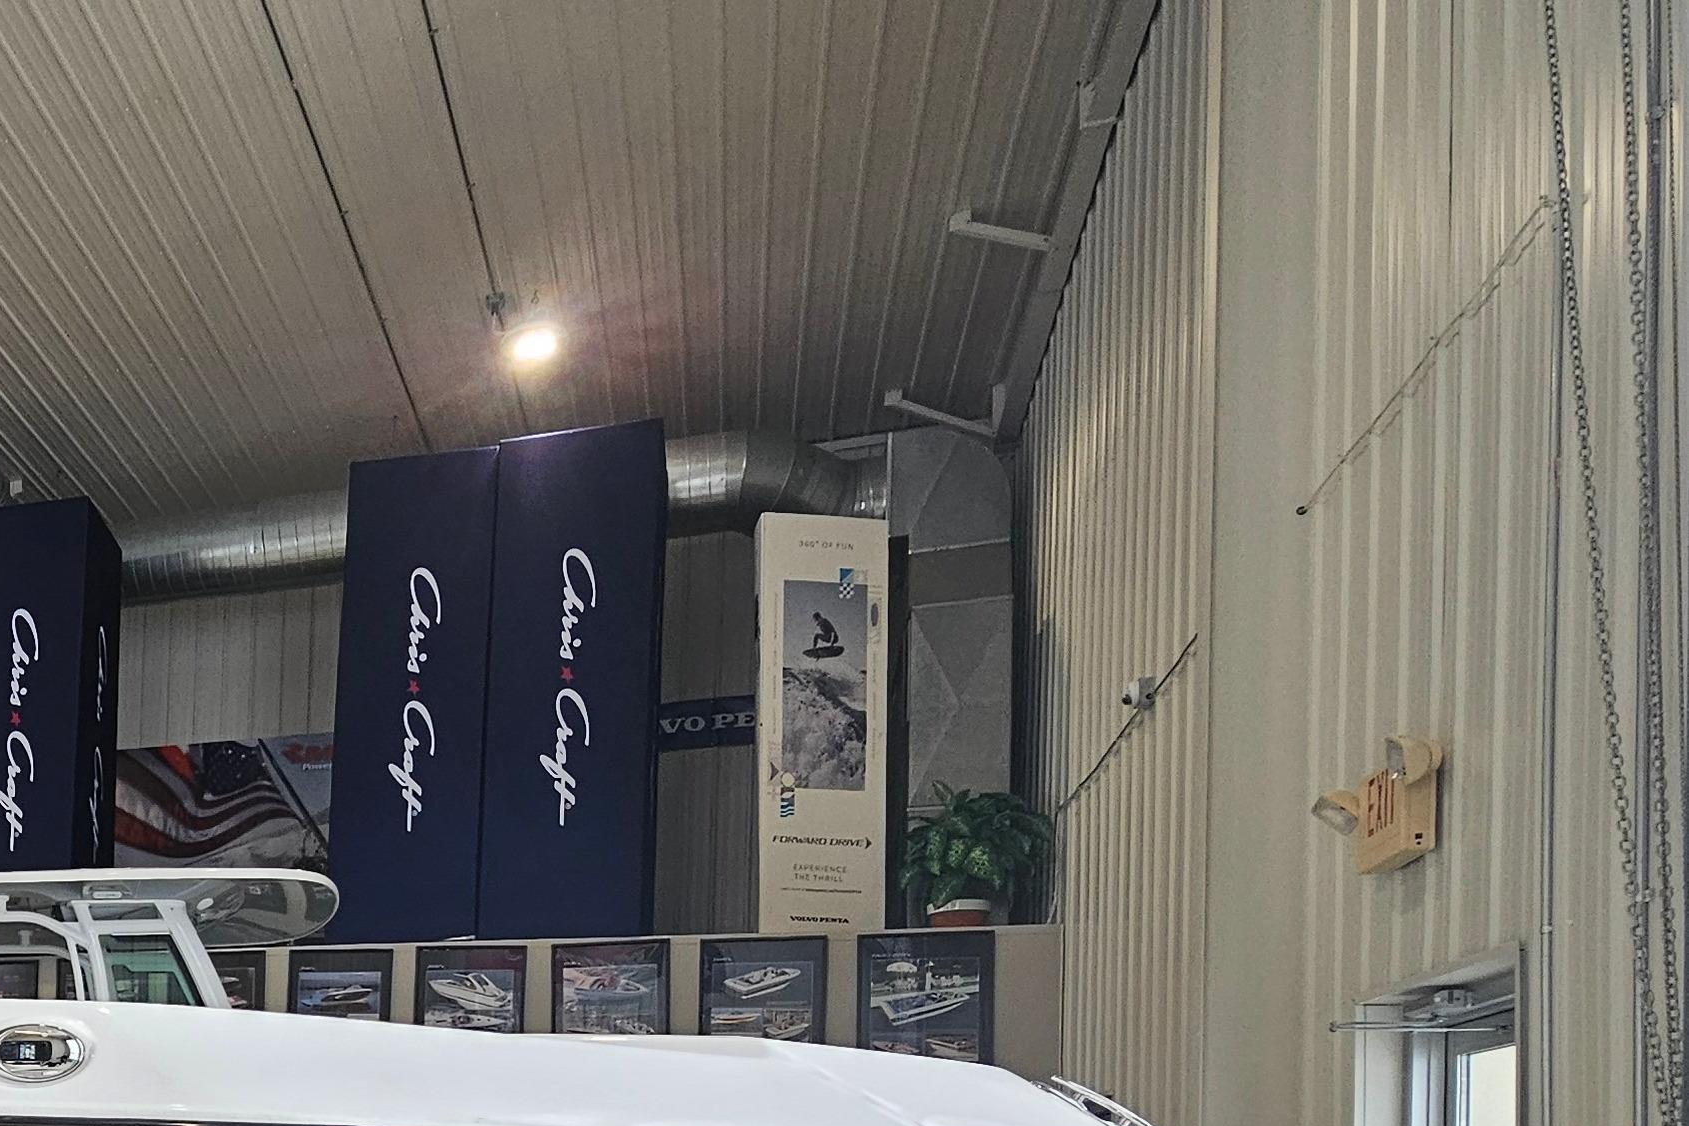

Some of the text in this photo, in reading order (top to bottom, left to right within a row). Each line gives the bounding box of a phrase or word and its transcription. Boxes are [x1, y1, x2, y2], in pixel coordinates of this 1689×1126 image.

[836, 542, 854, 551] FUN
[10, 608, 39, 706] Chris
[540, 548, 596, 826] Chris Craft
[388, 567, 441, 832] Chris Craft
[772, 835, 865, 848] FORWARD DRIVE
[793, 863, 847, 874] EXPERIENCE
[794, 872, 843, 883] THE THRILL
[790, 915, 849, 924] VOLVO PENTA
